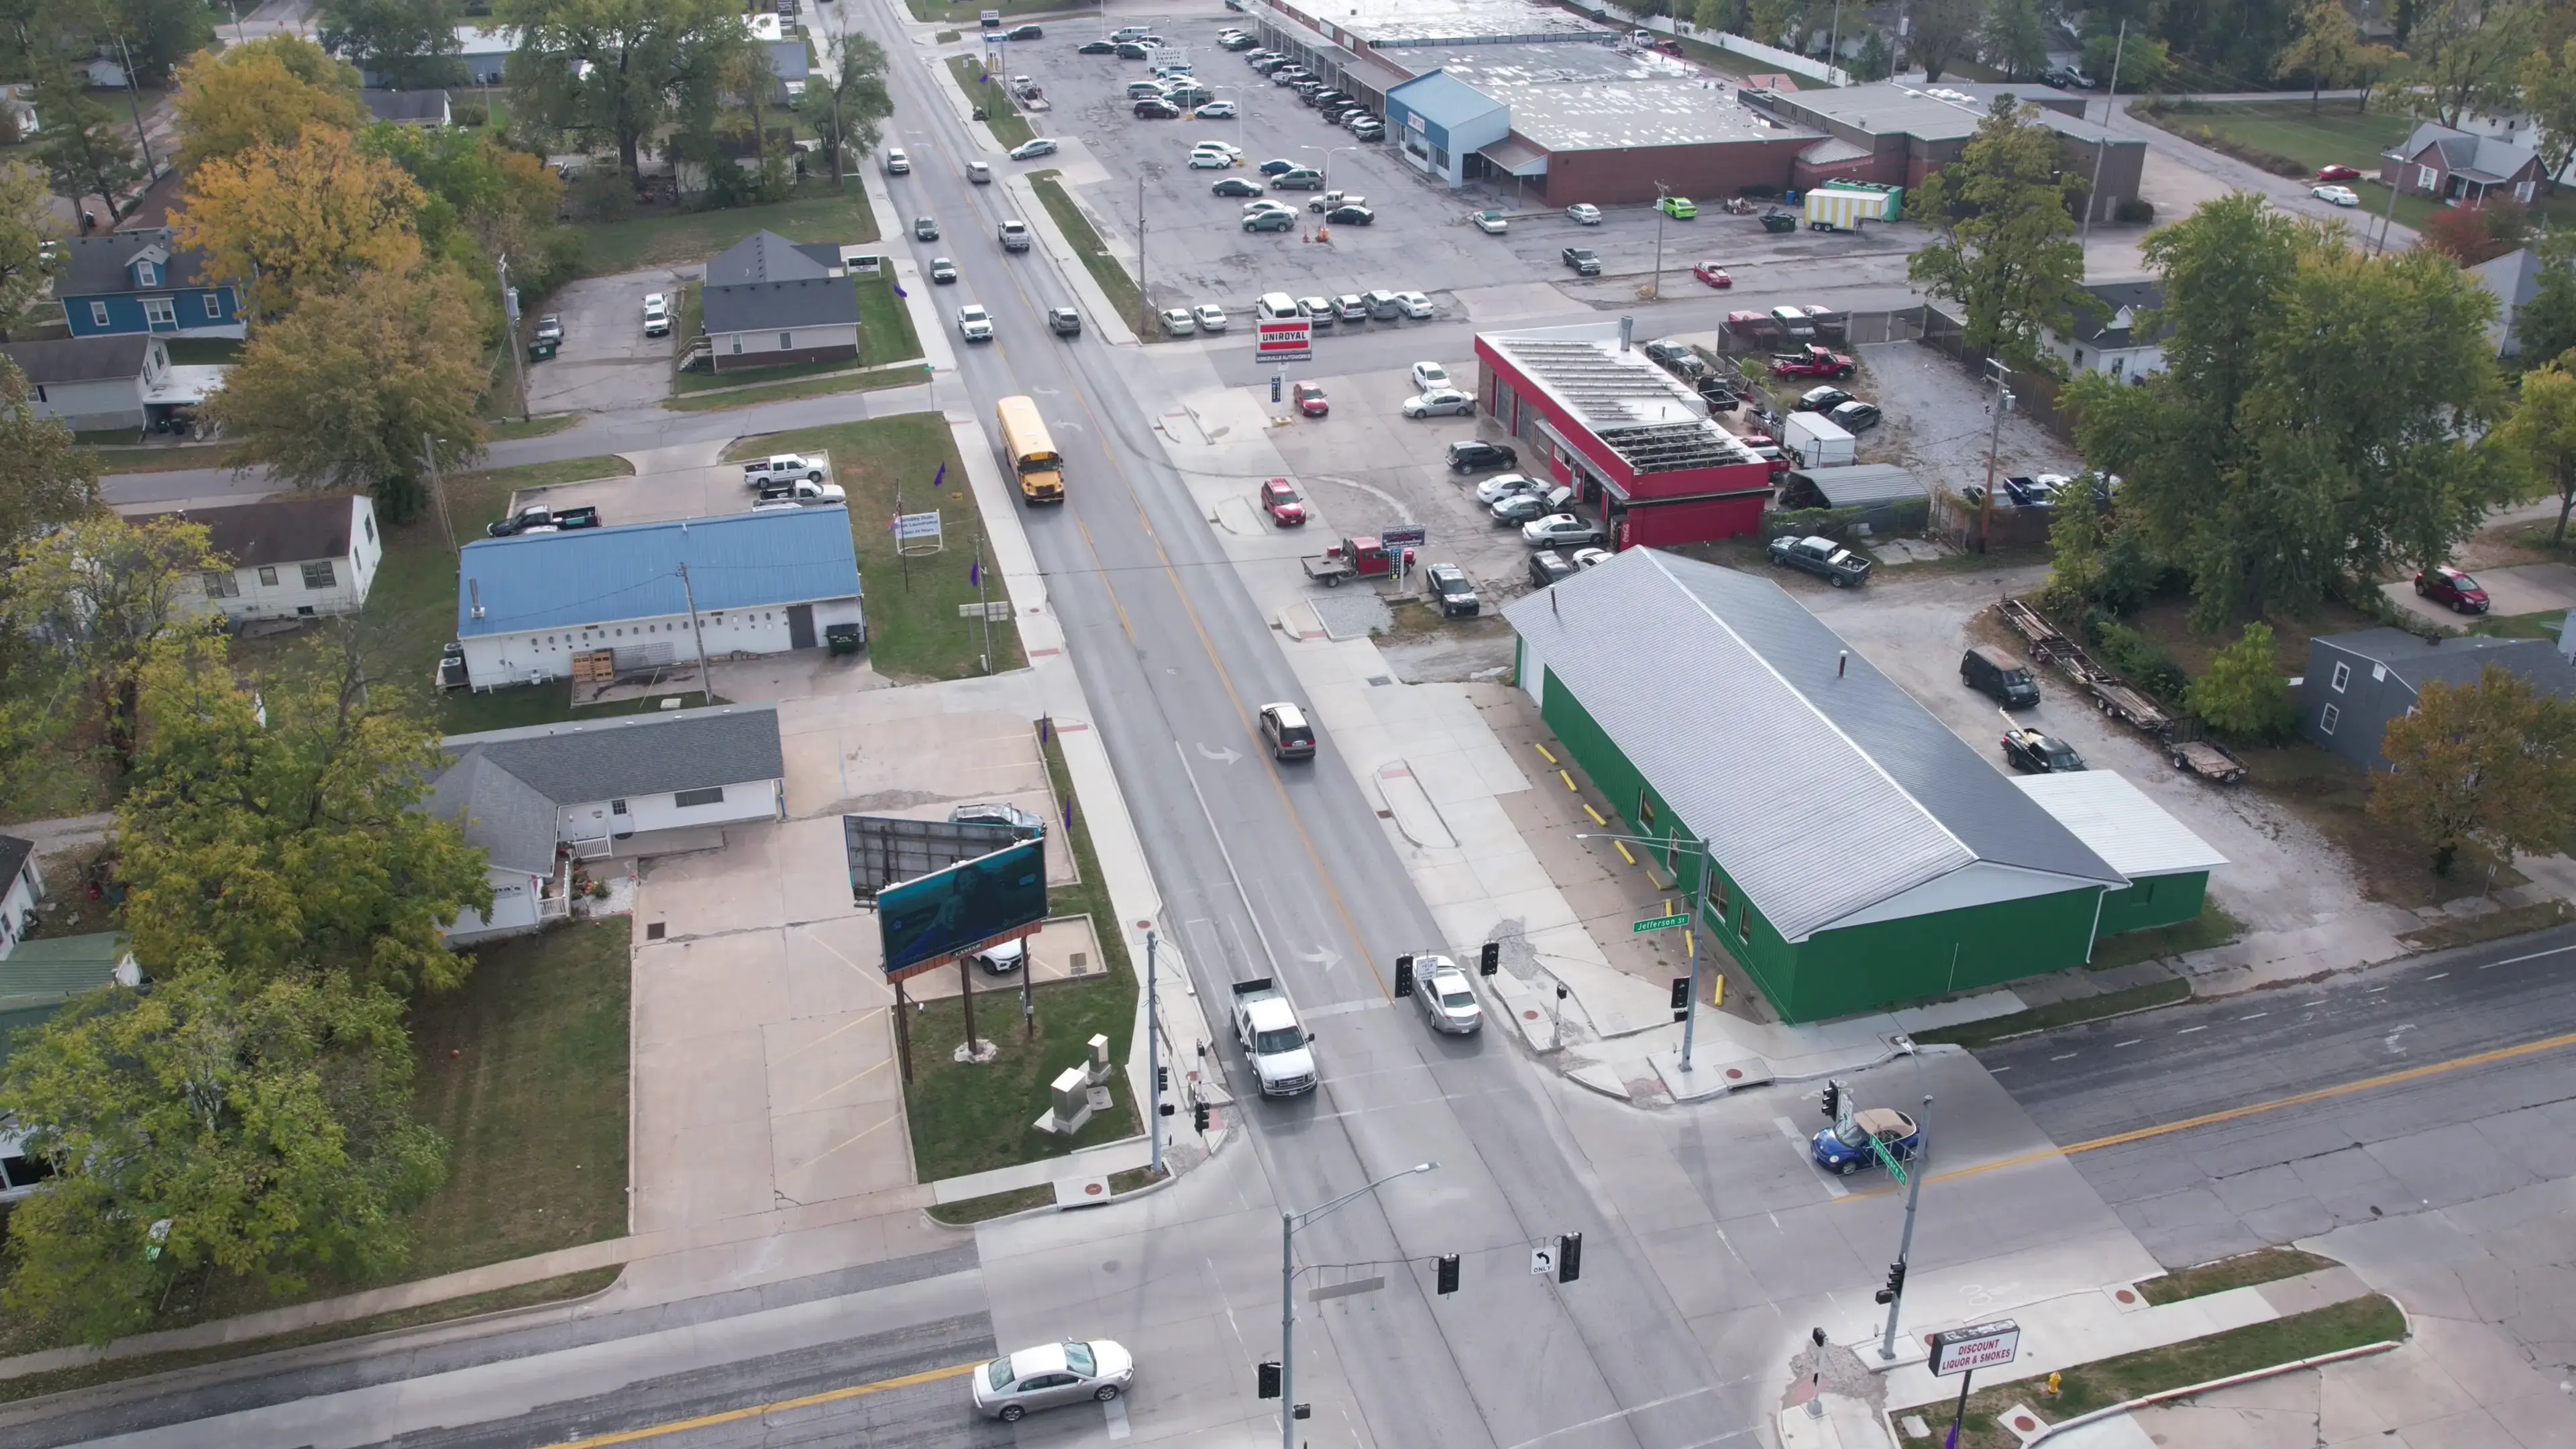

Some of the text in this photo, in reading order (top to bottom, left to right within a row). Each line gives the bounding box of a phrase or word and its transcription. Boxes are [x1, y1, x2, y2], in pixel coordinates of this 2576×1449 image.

[1263, 331, 1306, 341] UNIROYAL
[1638, 918, 1676, 931] Jefferson
[1872, 1138, 1900, 1174] Baltimore
[1534, 1265, 1552, 1273] ONLY
[1958, 1338, 2000, 1356] DISCOUNT
[1942, 1348, 2011, 1370] LIQUOR & SMOKES
